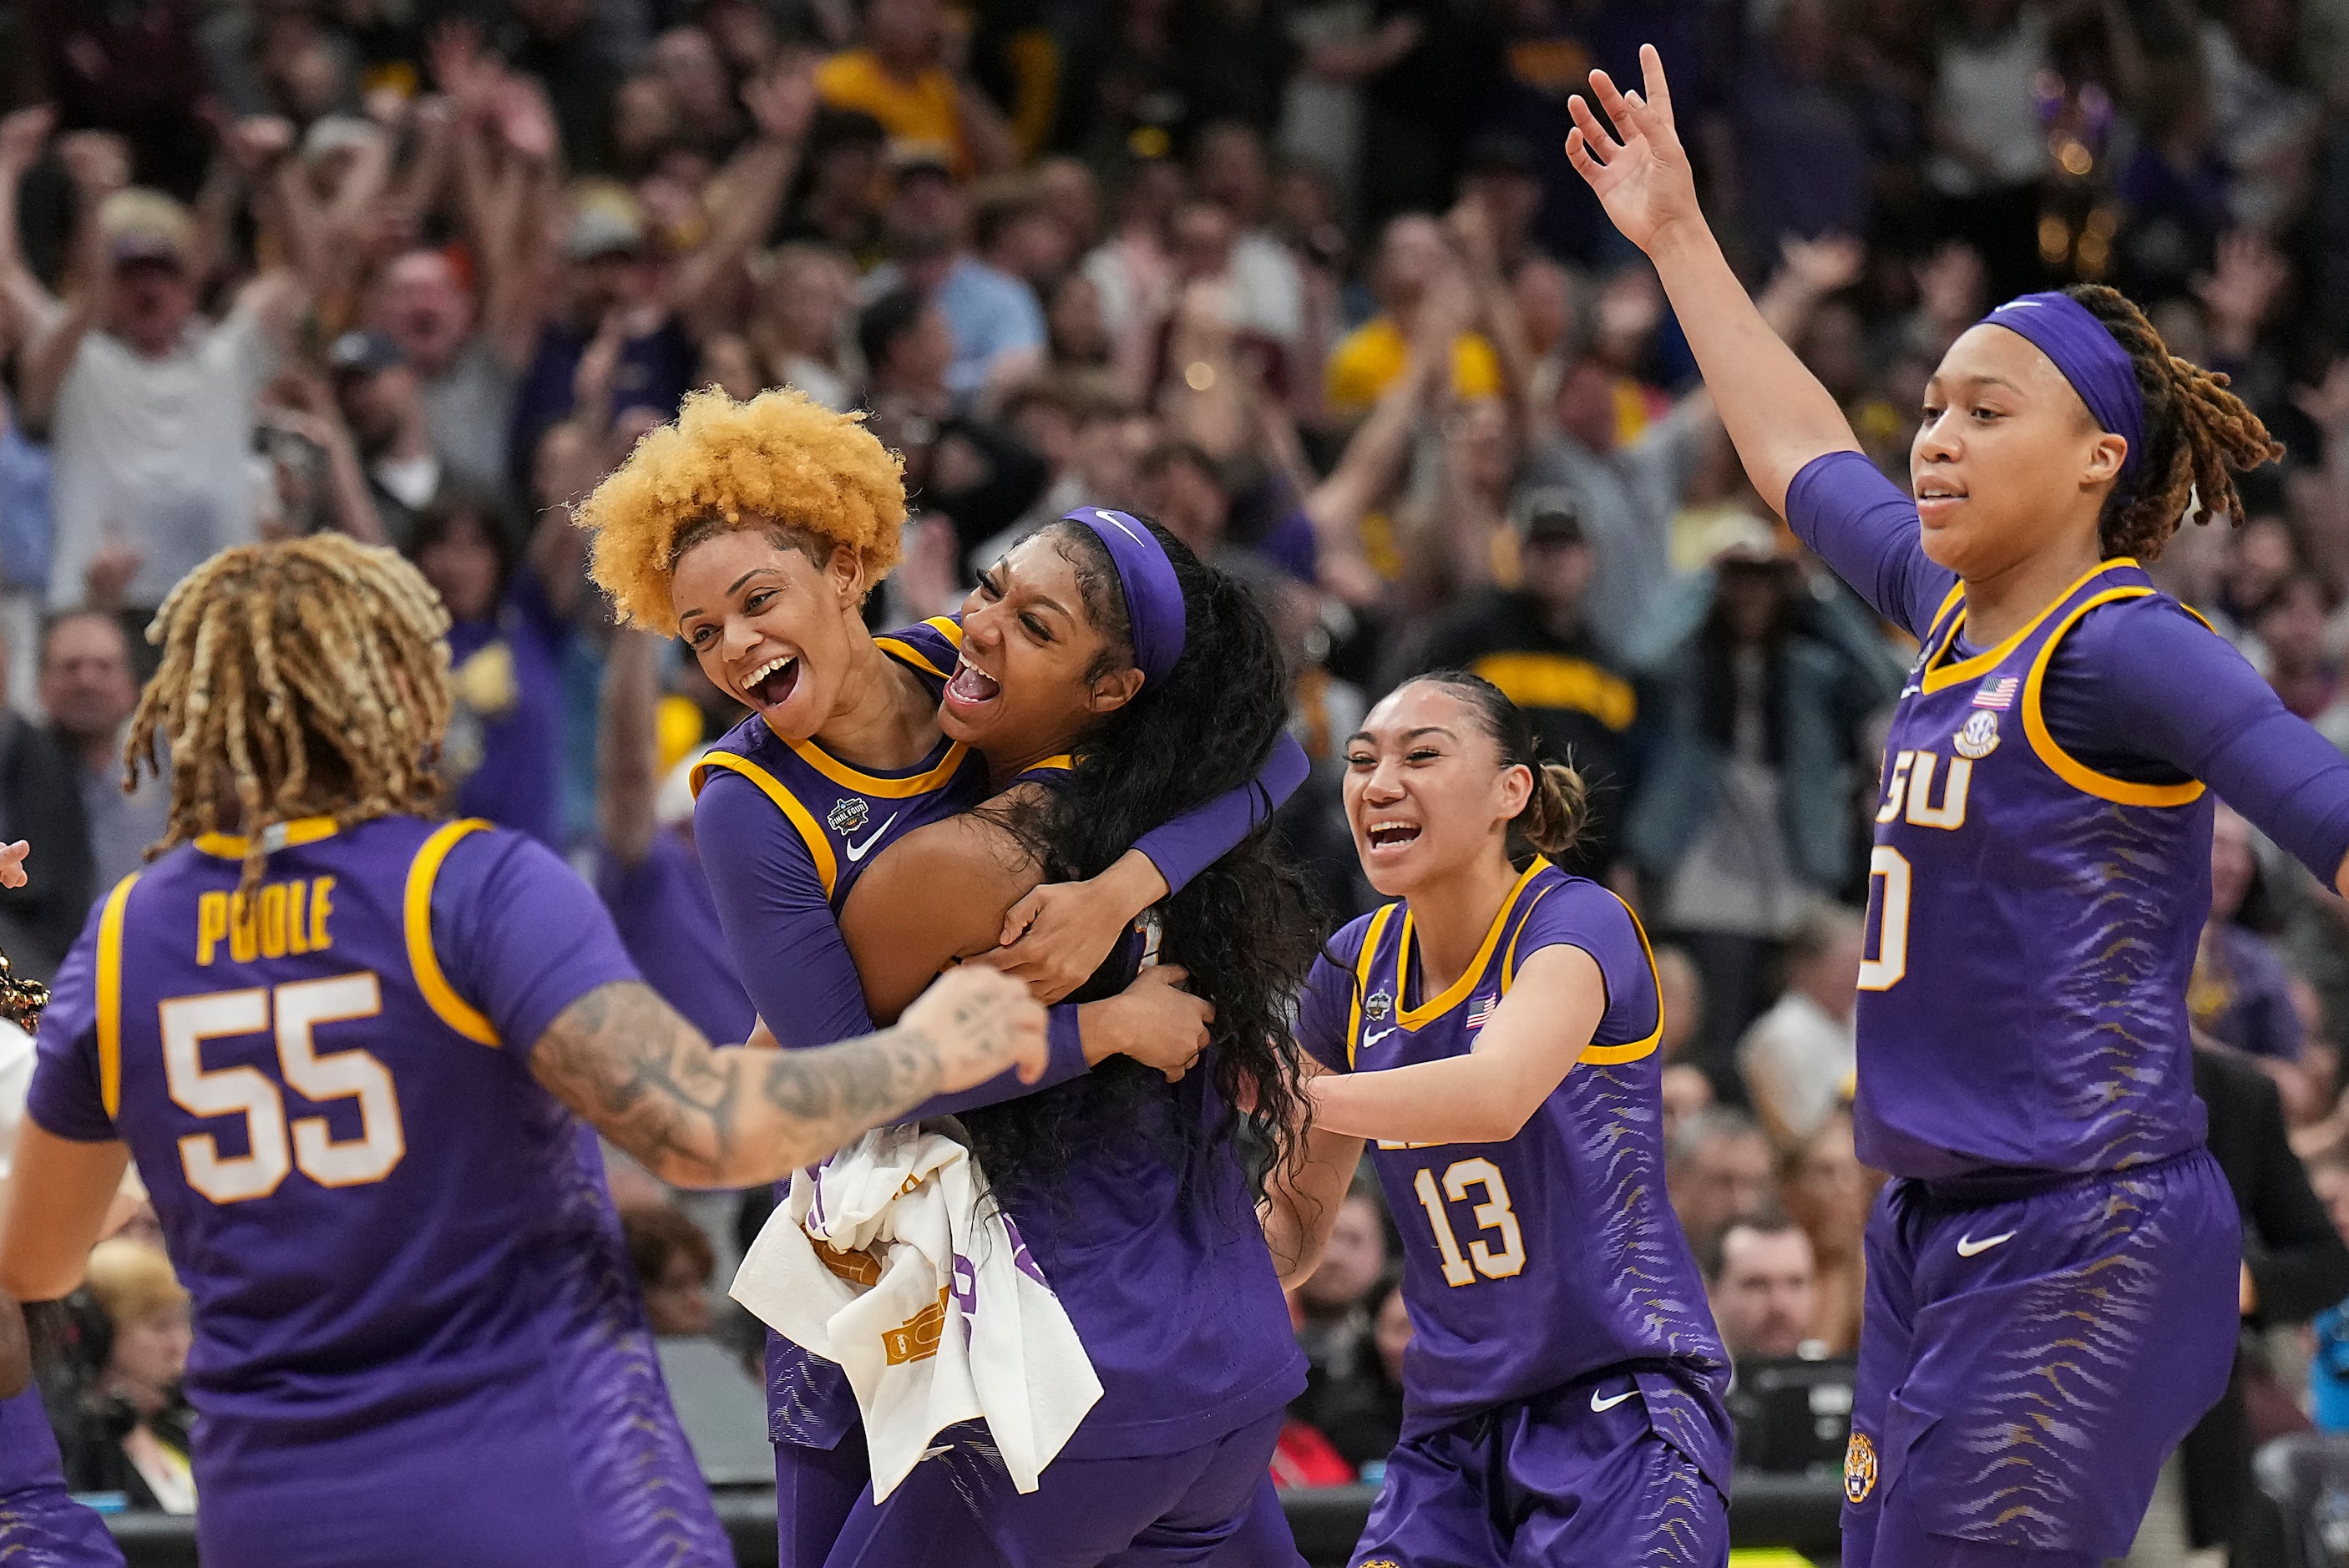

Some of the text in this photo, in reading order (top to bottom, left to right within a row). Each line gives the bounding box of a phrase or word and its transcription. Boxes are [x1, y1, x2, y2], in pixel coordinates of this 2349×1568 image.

[831, 803, 866, 827] FINAL FOUR
[1876, 748, 1973, 831] SU
[195, 875, 336, 966] POOLE
[158, 971, 407, 1205] 55
[1413, 1156, 1526, 1287] 13
